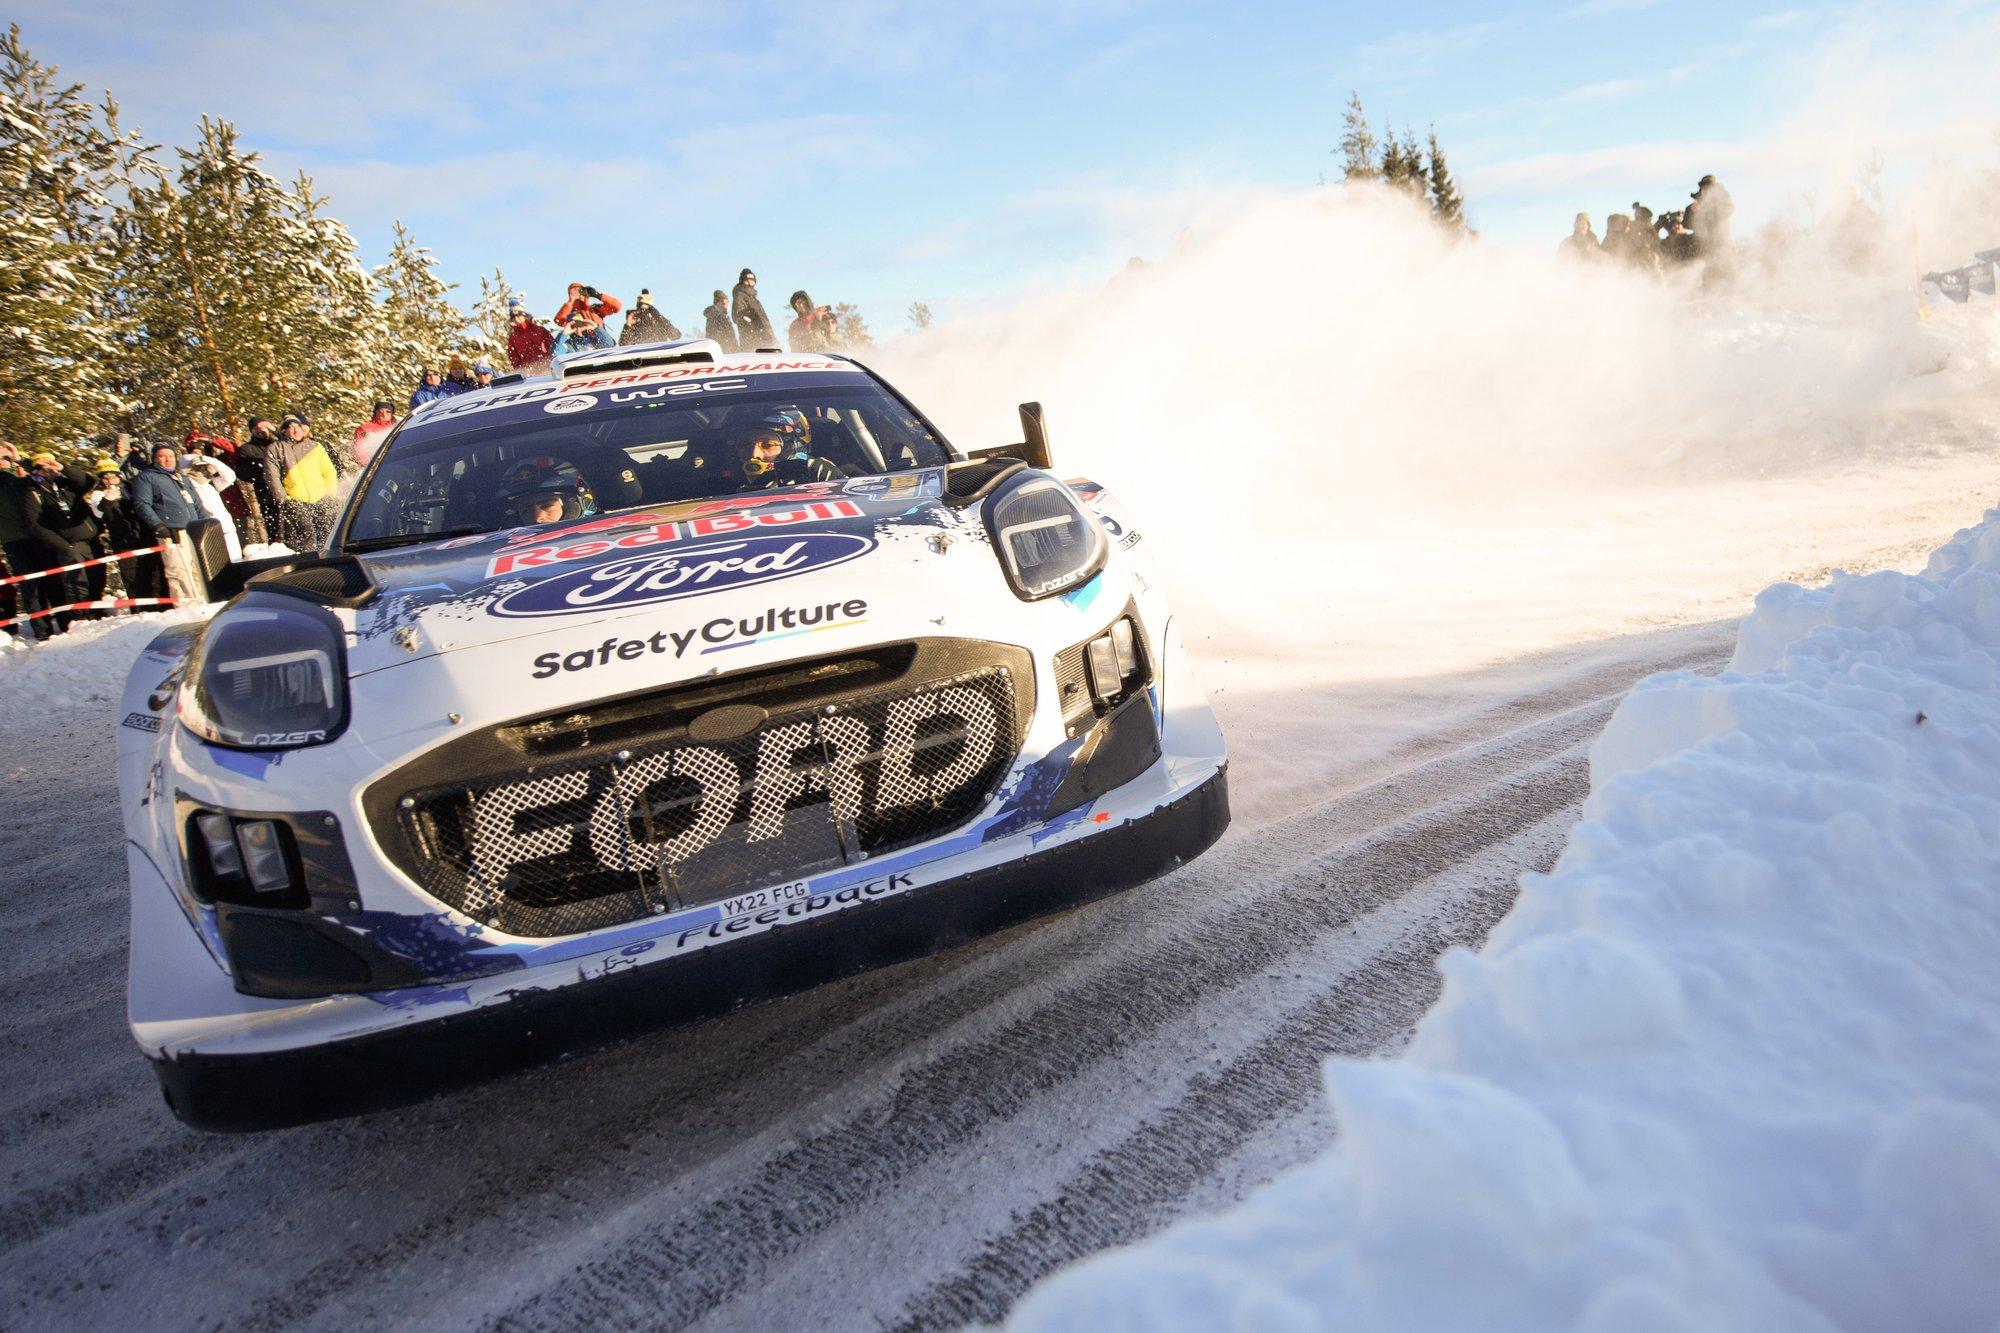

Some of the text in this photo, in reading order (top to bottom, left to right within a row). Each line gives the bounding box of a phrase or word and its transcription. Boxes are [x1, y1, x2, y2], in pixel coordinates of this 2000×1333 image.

[419, 362, 844, 422] FORD PERFORMANCE
[611, 379, 748, 402] WRC
[487, 500, 863, 577] Red Bull
[565, 541, 808, 606] Ford
[532, 599, 868, 680] SafetyCulture
[461, 687, 999, 912] FORD
[677, 871, 914, 948] Fleetback
[724, 882, 805, 916] YX22 FCG
